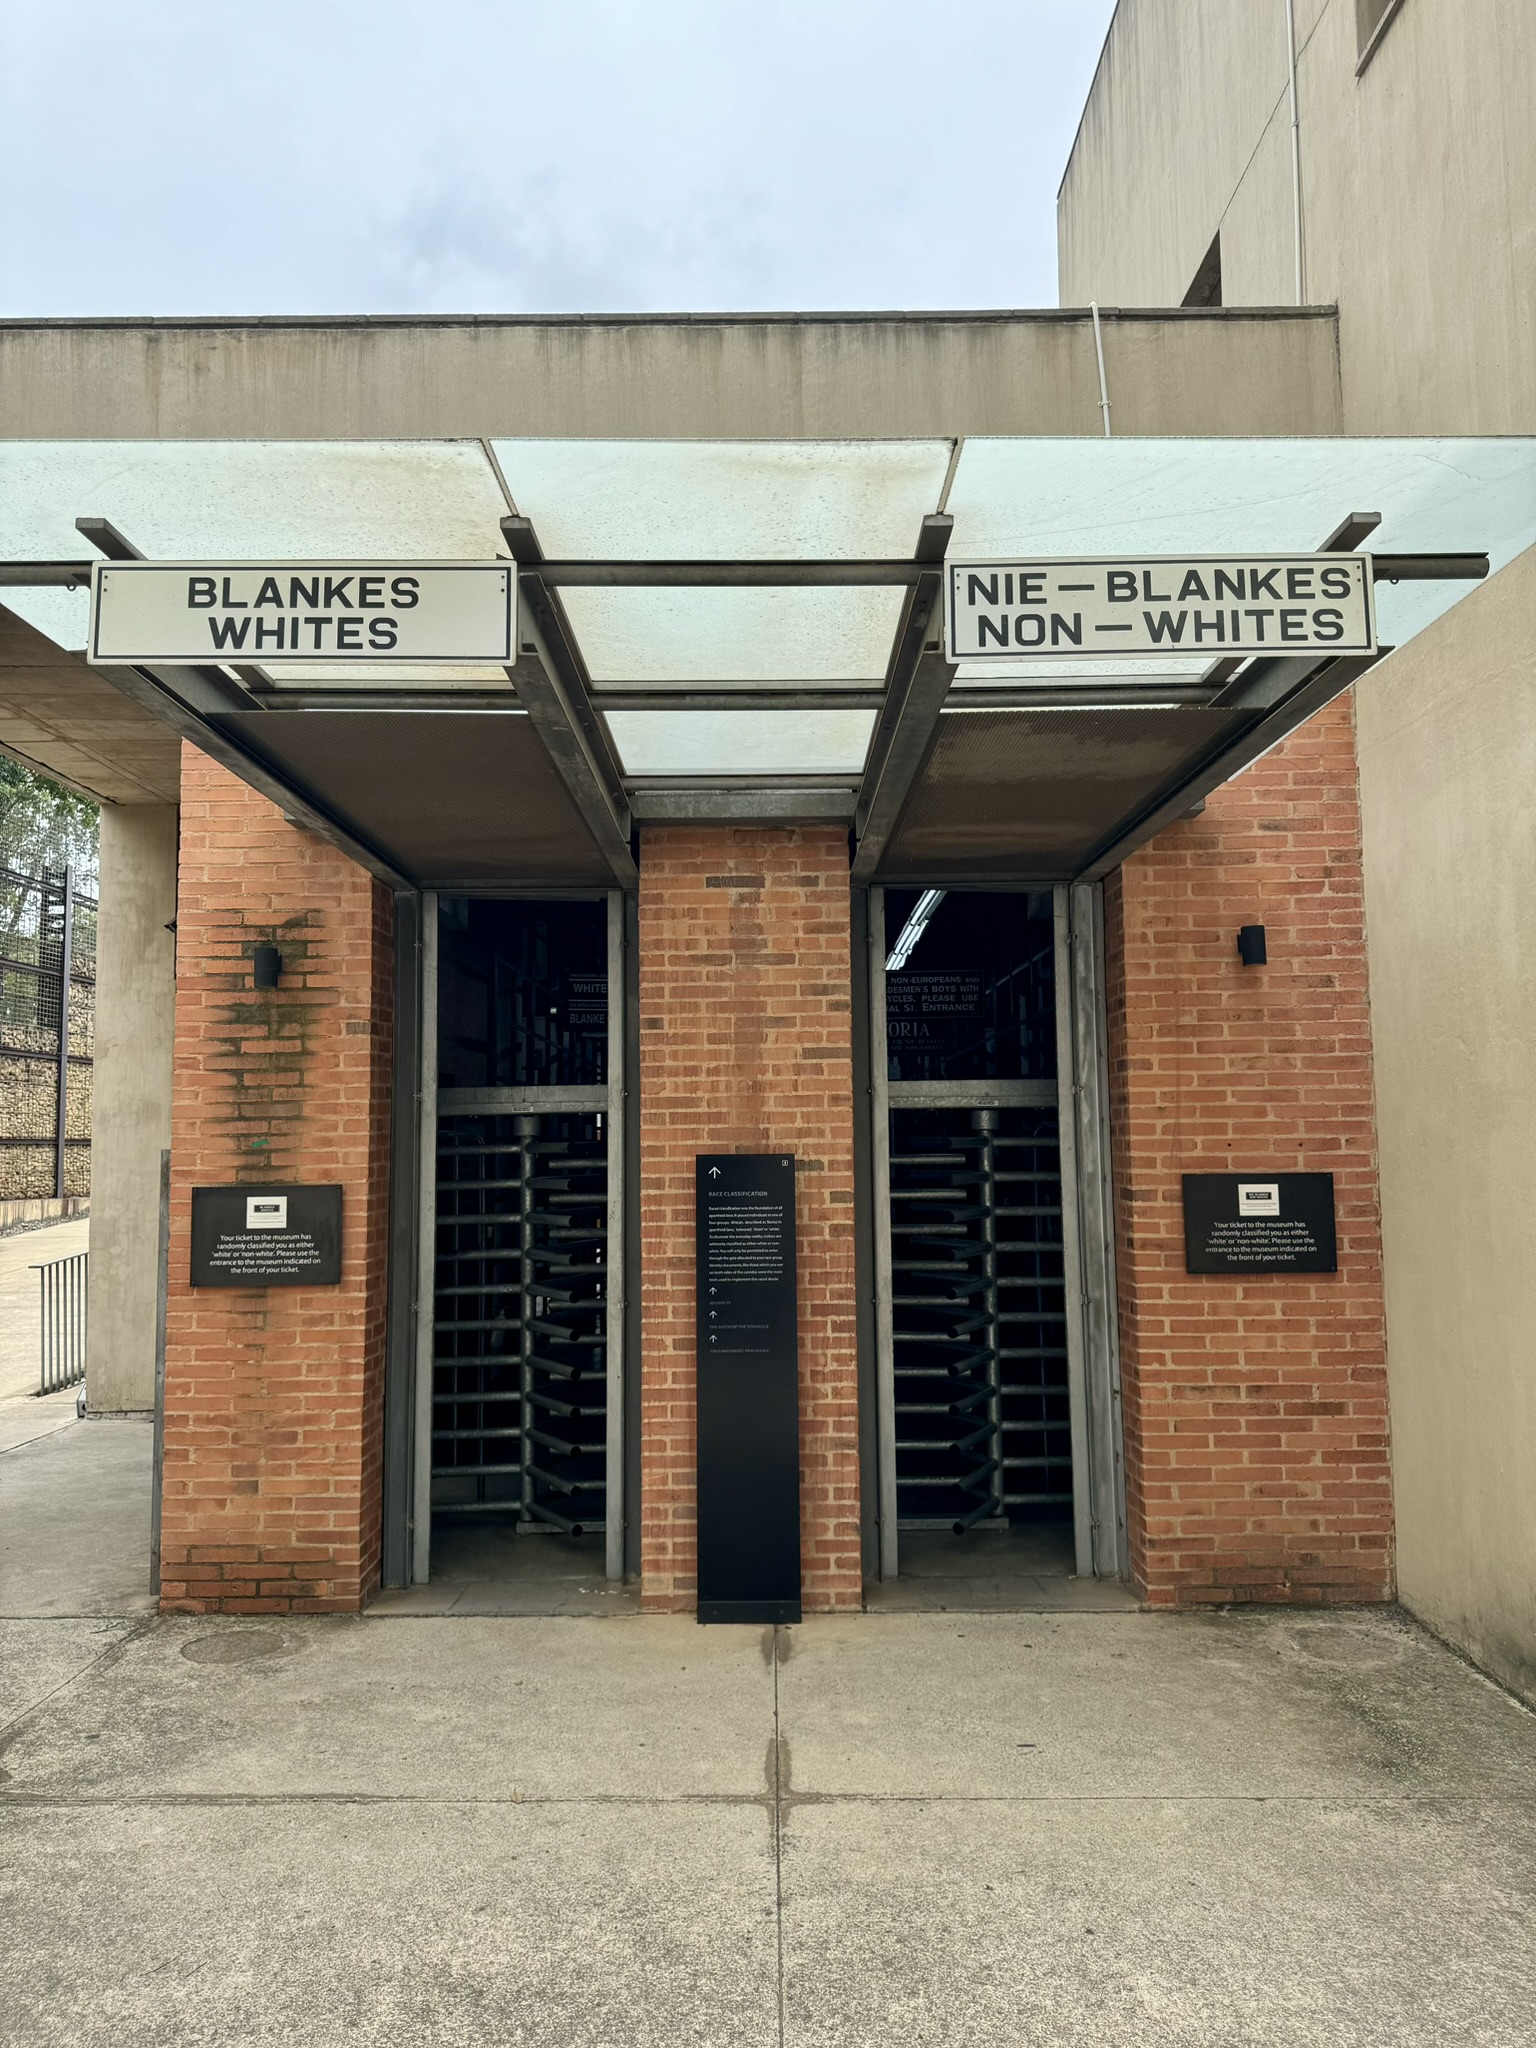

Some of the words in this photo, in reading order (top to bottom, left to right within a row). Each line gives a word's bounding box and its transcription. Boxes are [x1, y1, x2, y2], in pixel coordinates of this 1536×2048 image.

[188, 577, 420, 609] BLANKES
[208, 616, 399, 650] WHITES
[887, 1022, 930, 1036] ORIA
